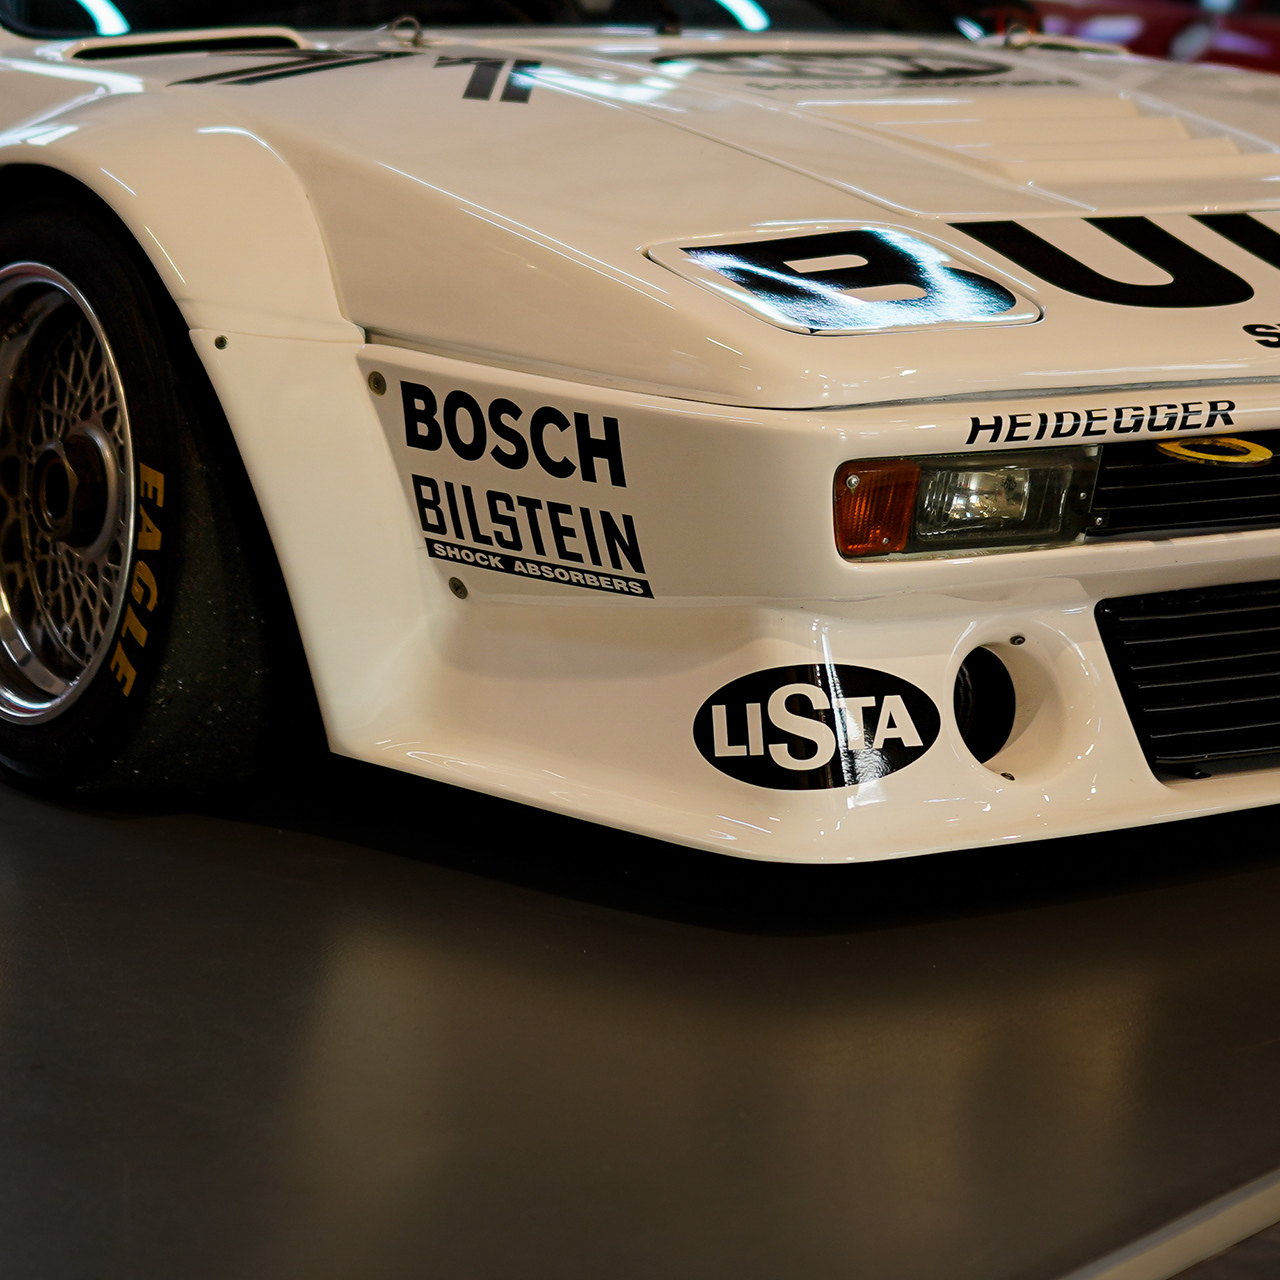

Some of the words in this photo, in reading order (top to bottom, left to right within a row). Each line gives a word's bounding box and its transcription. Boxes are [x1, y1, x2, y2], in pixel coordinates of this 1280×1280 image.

[400, 380, 627, 488] BOSCH
[966, 400, 1236, 445] HEIDEGGER
[411, 473, 646, 574] BILSTEIN
[433, 543, 505, 569] SHOCK
[514, 559, 645, 595] ABSORBERS
[109, 461, 166, 697] EAGLE
[711, 682, 924, 771] LISTA
